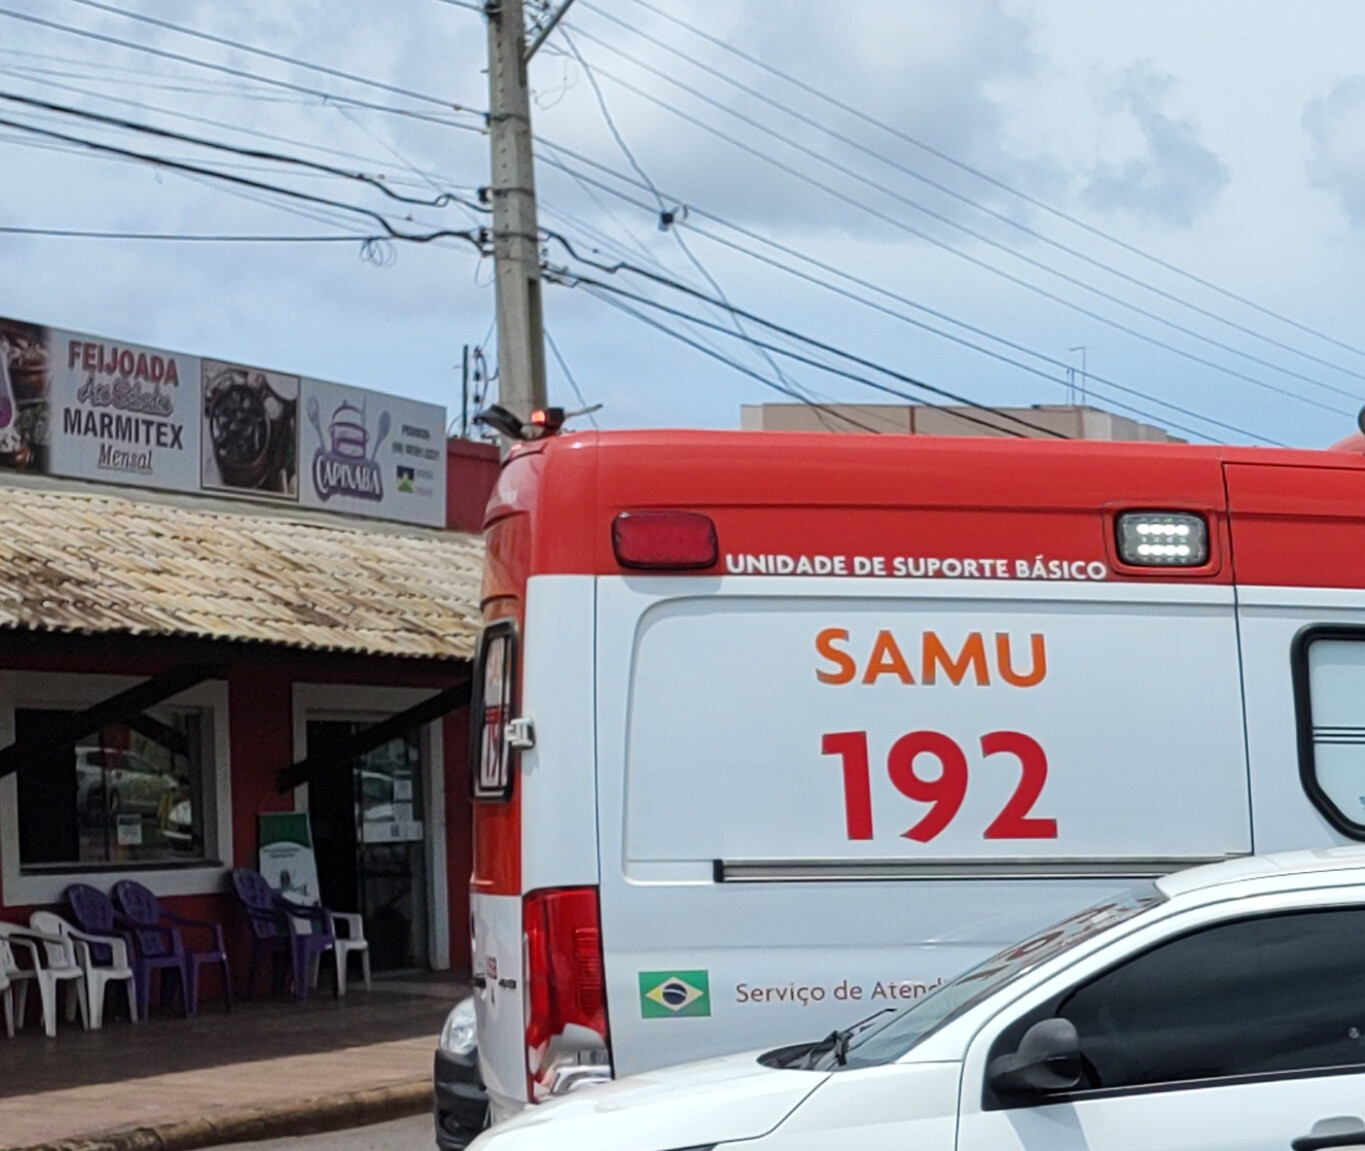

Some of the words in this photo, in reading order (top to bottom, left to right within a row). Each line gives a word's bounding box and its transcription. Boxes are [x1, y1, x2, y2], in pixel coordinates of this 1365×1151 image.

[68, 340, 179, 388] FEIJOADA
[63, 407, 183, 450] MARMITEX
[98, 443, 153, 471] Mensal
[725, 553, 848, 575] UNIDADE
[853, 556, 887, 576] DE
[892, 557, 1009, 578] SUPORTE
[1015, 553, 1107, 580] BÁSICO
[815, 627, 1047, 688] SAMU
[821, 730, 1058, 843] 192
[736, 982, 826, 1007] Serviço
[833, 980, 863, 1000] de
